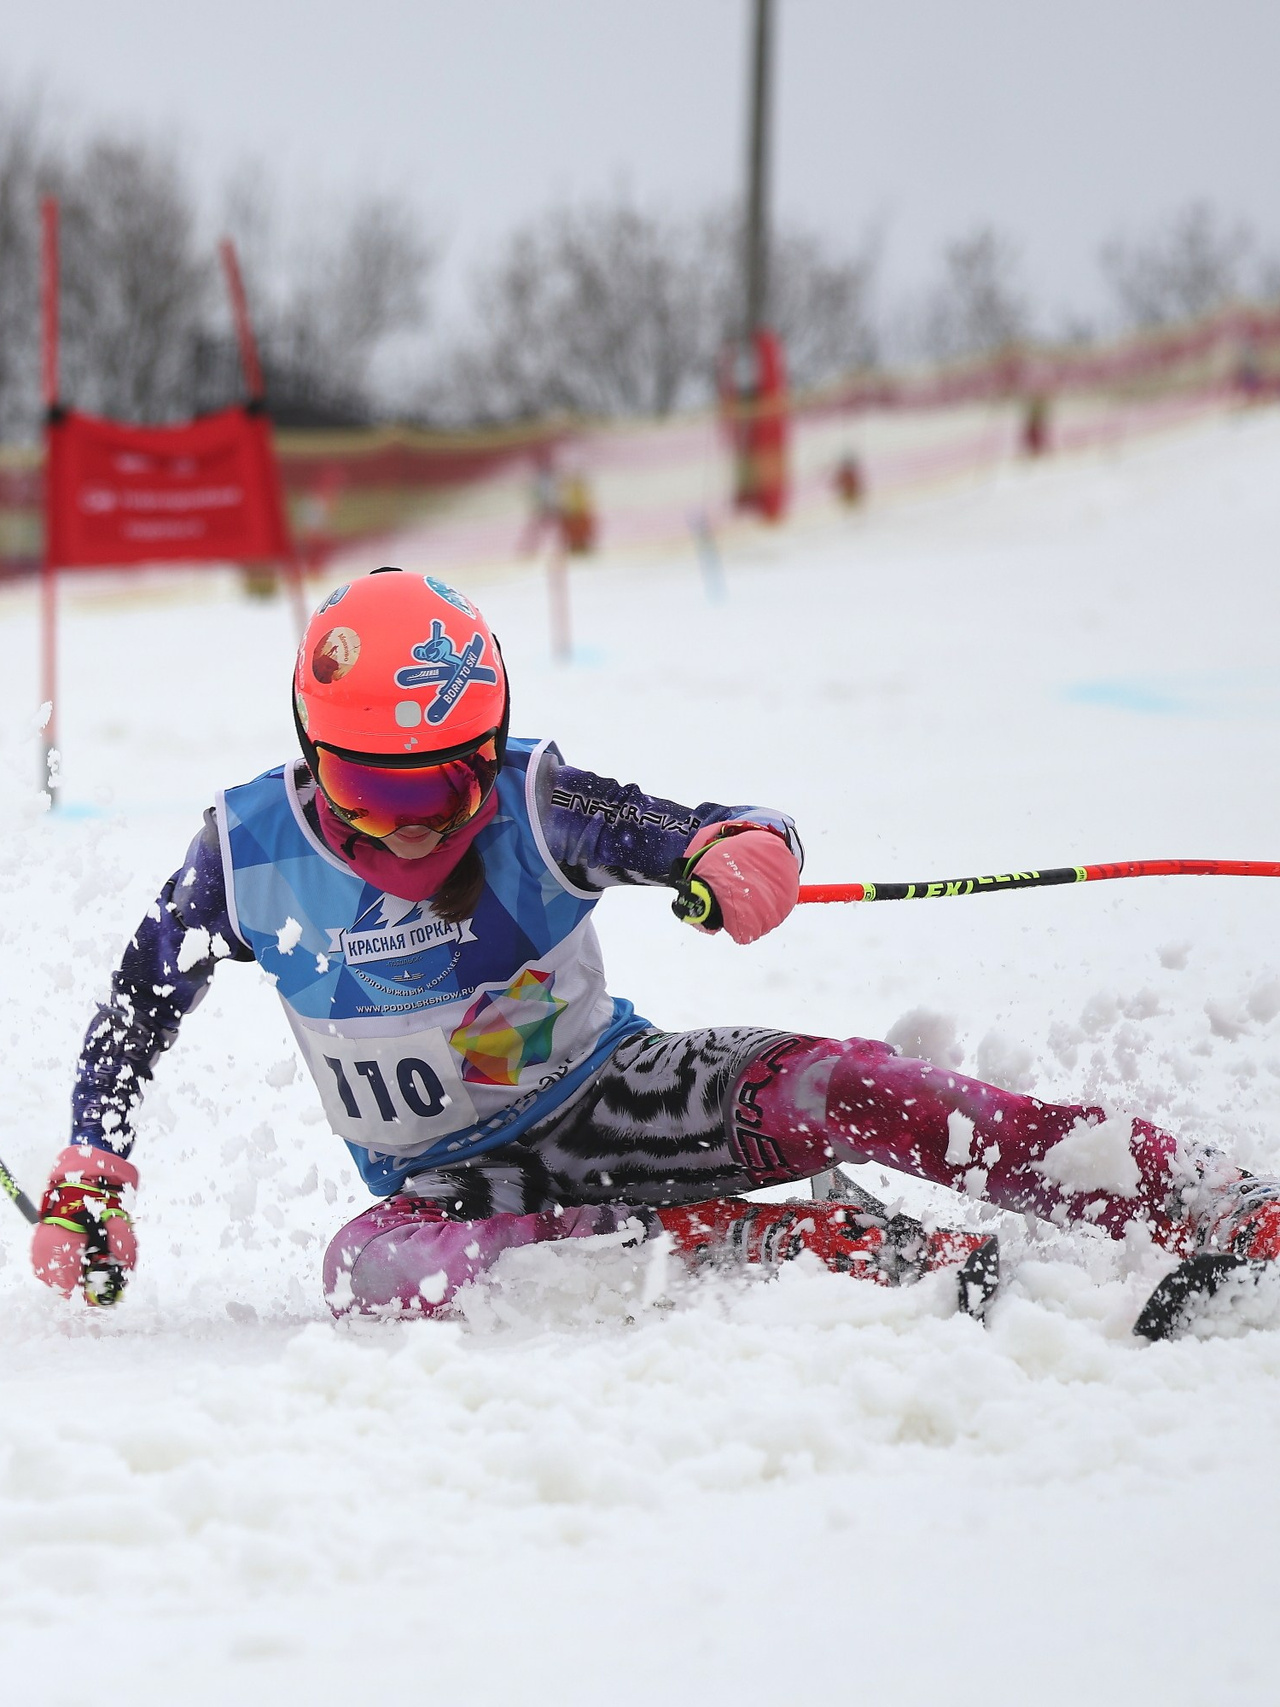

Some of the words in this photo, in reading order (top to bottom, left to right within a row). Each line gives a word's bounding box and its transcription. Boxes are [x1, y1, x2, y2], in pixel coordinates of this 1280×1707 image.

[442, 677, 464, 704] BORN
[459, 666, 471, 679] TO
[467, 651, 478, 668] SKI
[348, 933, 406, 957] КРАСНАЯ
[410, 922, 454, 946] ГОРКА
[354, 968, 425, 997] ГОРНОЛЫЖНЫЙ
[426, 950, 462, 990] КОМПЛЕКС
[356, 986, 476, 1014] WWW.PODOLSKSNOW.RU
[323, 1054, 447, 1121] 110
